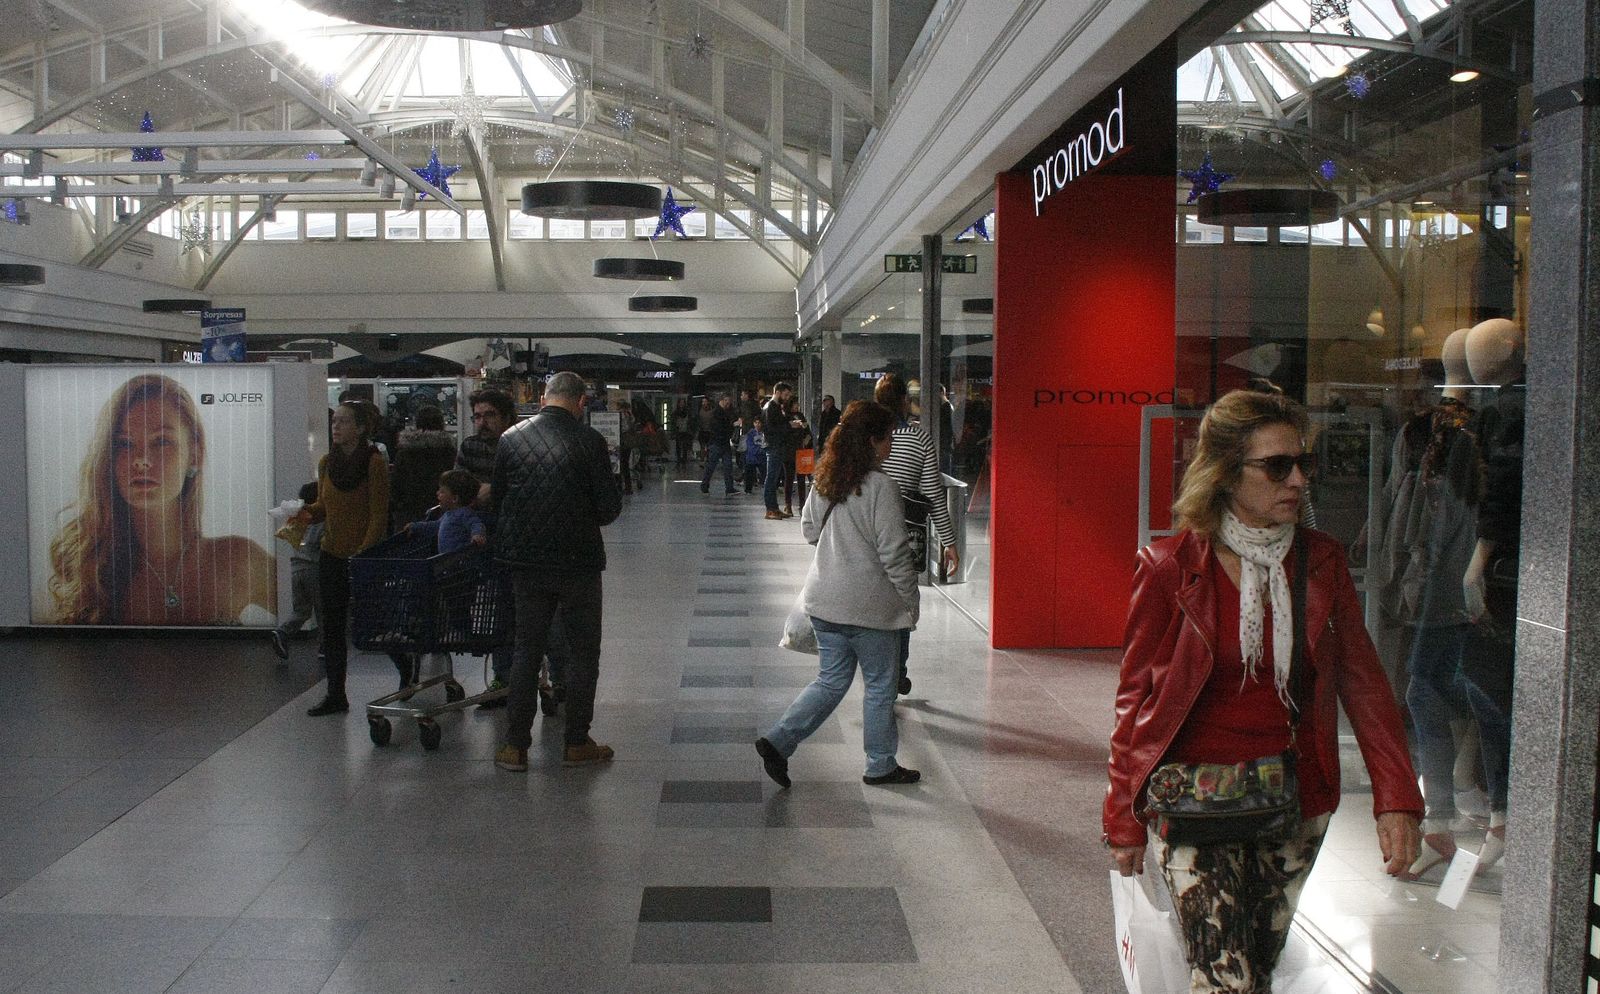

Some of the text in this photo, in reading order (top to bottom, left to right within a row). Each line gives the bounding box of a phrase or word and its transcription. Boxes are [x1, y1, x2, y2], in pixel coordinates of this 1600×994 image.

[1033, 87, 1124, 217] promod
[203, 311, 243, 320] Sorpresas
[219, 393, 263, 403] JOLFER
[1034, 387, 1176, 408] promod
